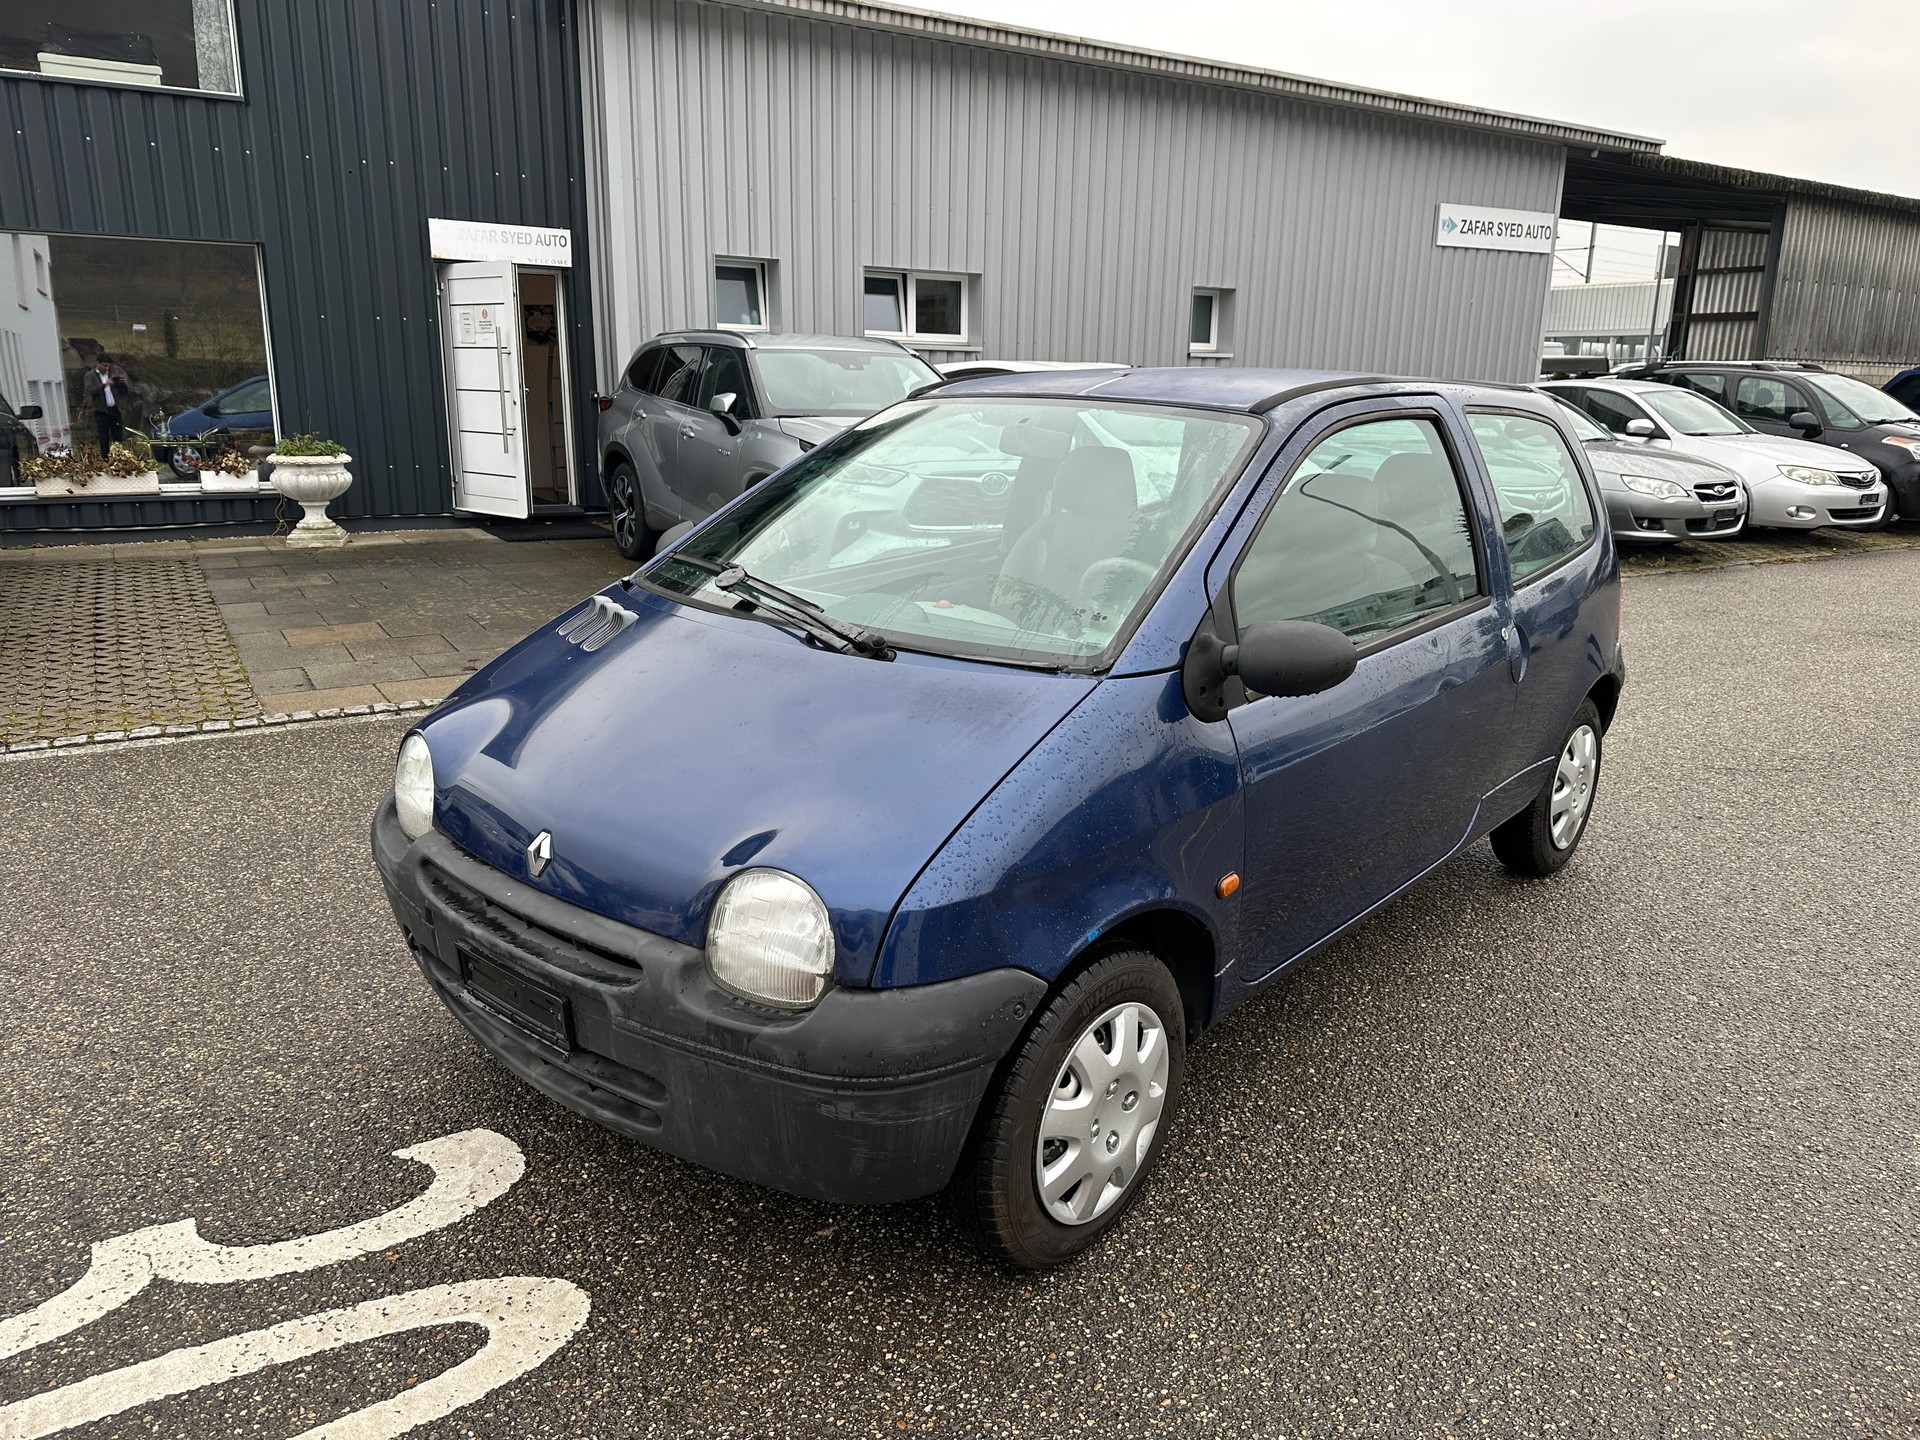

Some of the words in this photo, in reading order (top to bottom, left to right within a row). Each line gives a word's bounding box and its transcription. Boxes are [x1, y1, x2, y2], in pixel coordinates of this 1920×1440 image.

[457, 227, 498, 243] ZAFAR
[500, 230, 533, 245] SYED
[535, 233, 568, 248] AUTO
[1460, 219, 1494, 236] ZAFAR
[1496, 222, 1523, 238] SYED
[1525, 224, 1552, 240] AUTO
[527, 257, 569, 266] WELCOME
